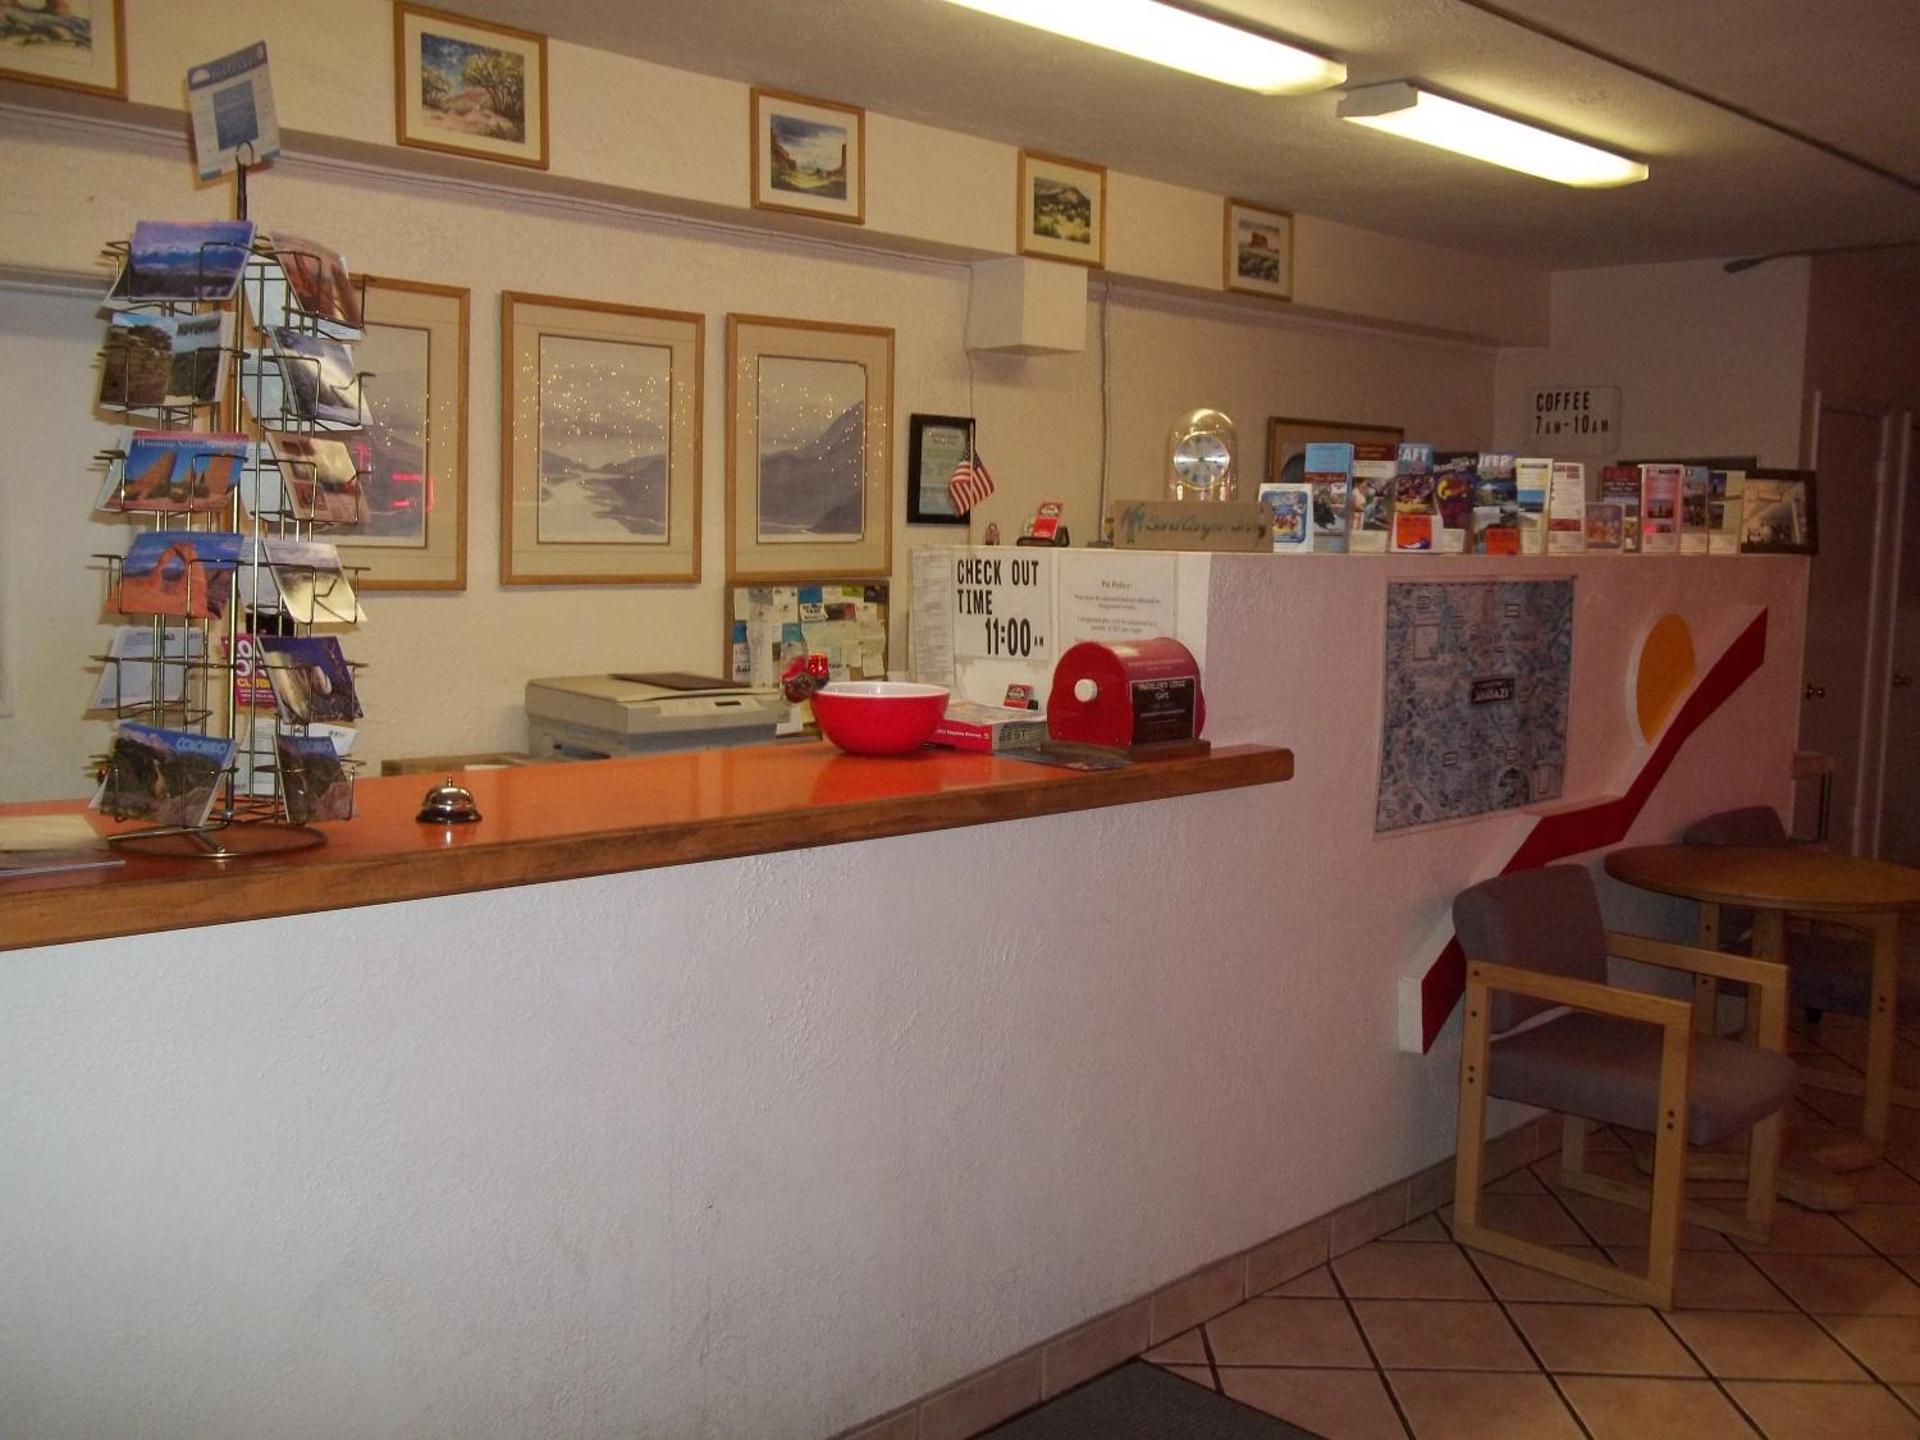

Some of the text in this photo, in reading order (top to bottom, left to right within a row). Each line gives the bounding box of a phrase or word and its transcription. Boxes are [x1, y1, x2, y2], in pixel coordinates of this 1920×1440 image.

[1536, 391, 1590, 412] COFFEE
[957, 559, 1039, 586] CHECK OUT
[957, 589, 993, 615] TIME
[985, 617, 1031, 657] 11:00
